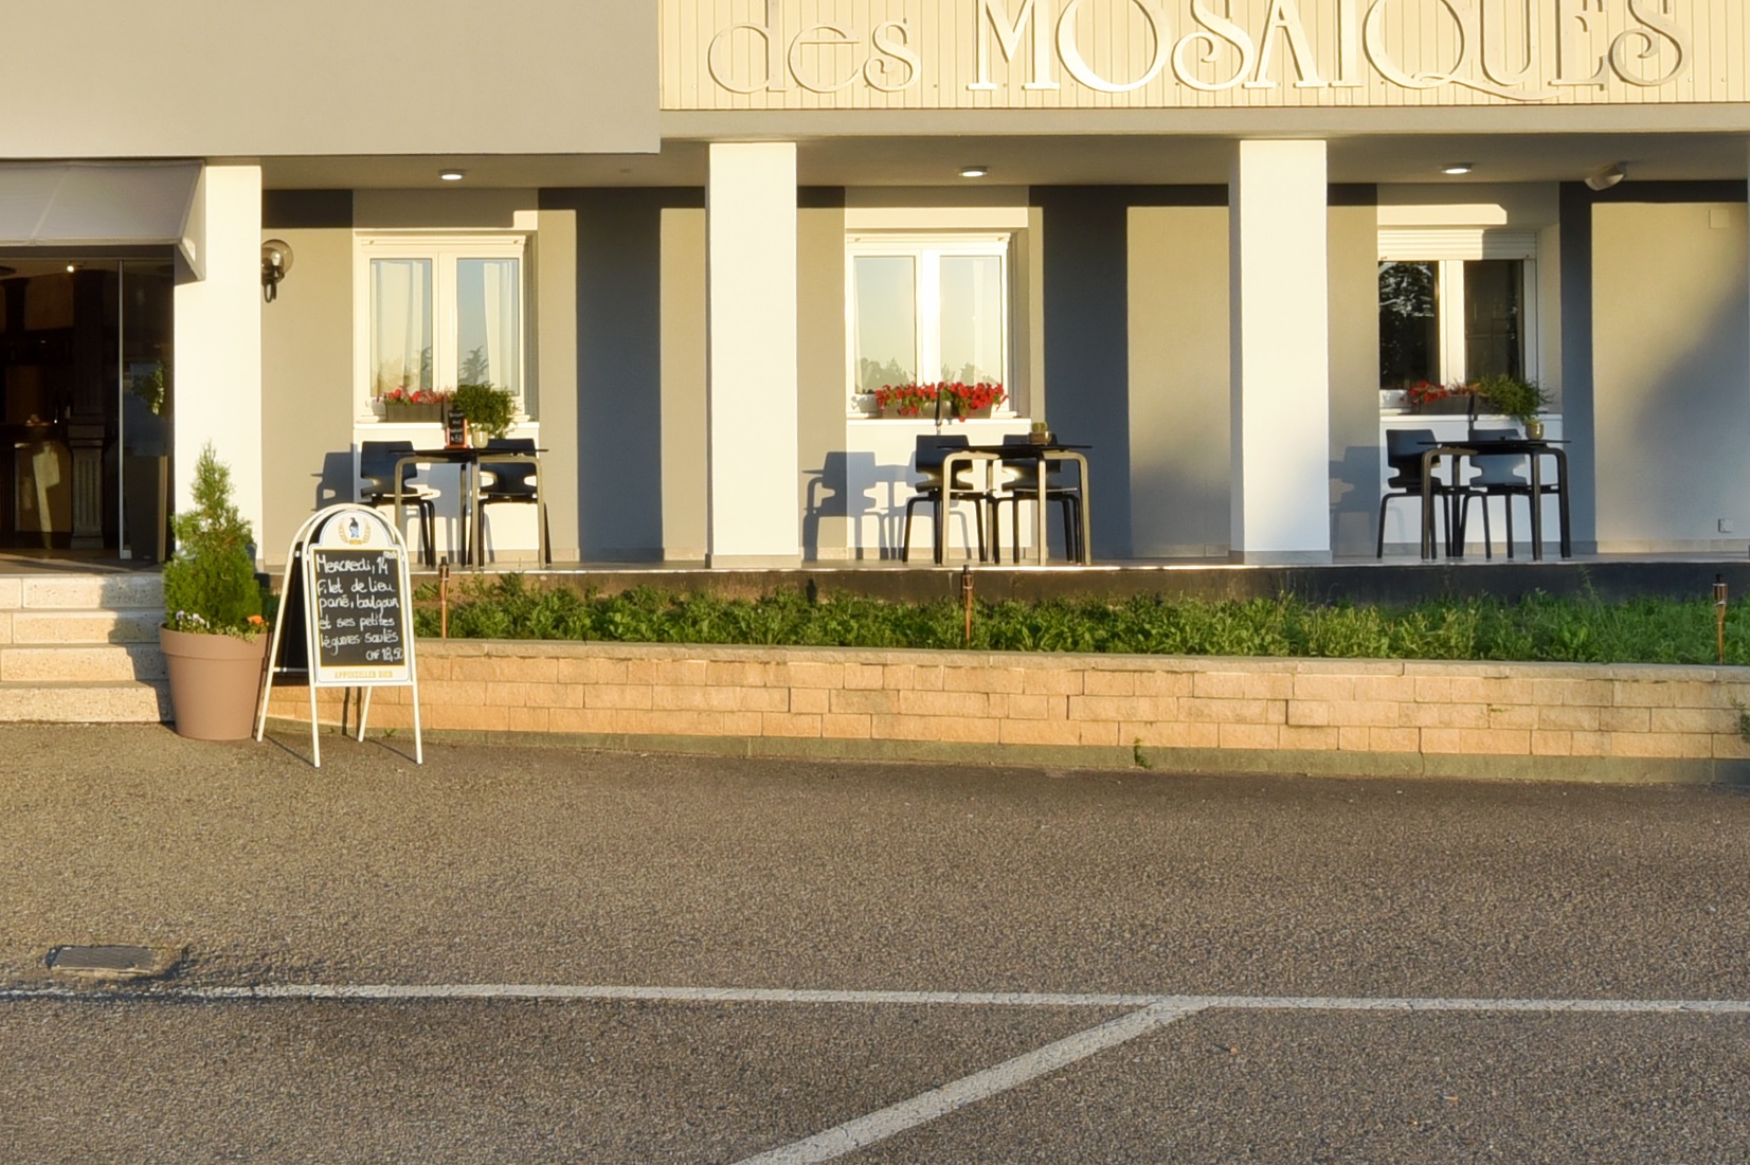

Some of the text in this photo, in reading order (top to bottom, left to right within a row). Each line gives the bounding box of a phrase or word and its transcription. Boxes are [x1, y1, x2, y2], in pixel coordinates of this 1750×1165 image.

[351, 578, 367, 593] de
[319, 612, 395, 632] et ses petites
